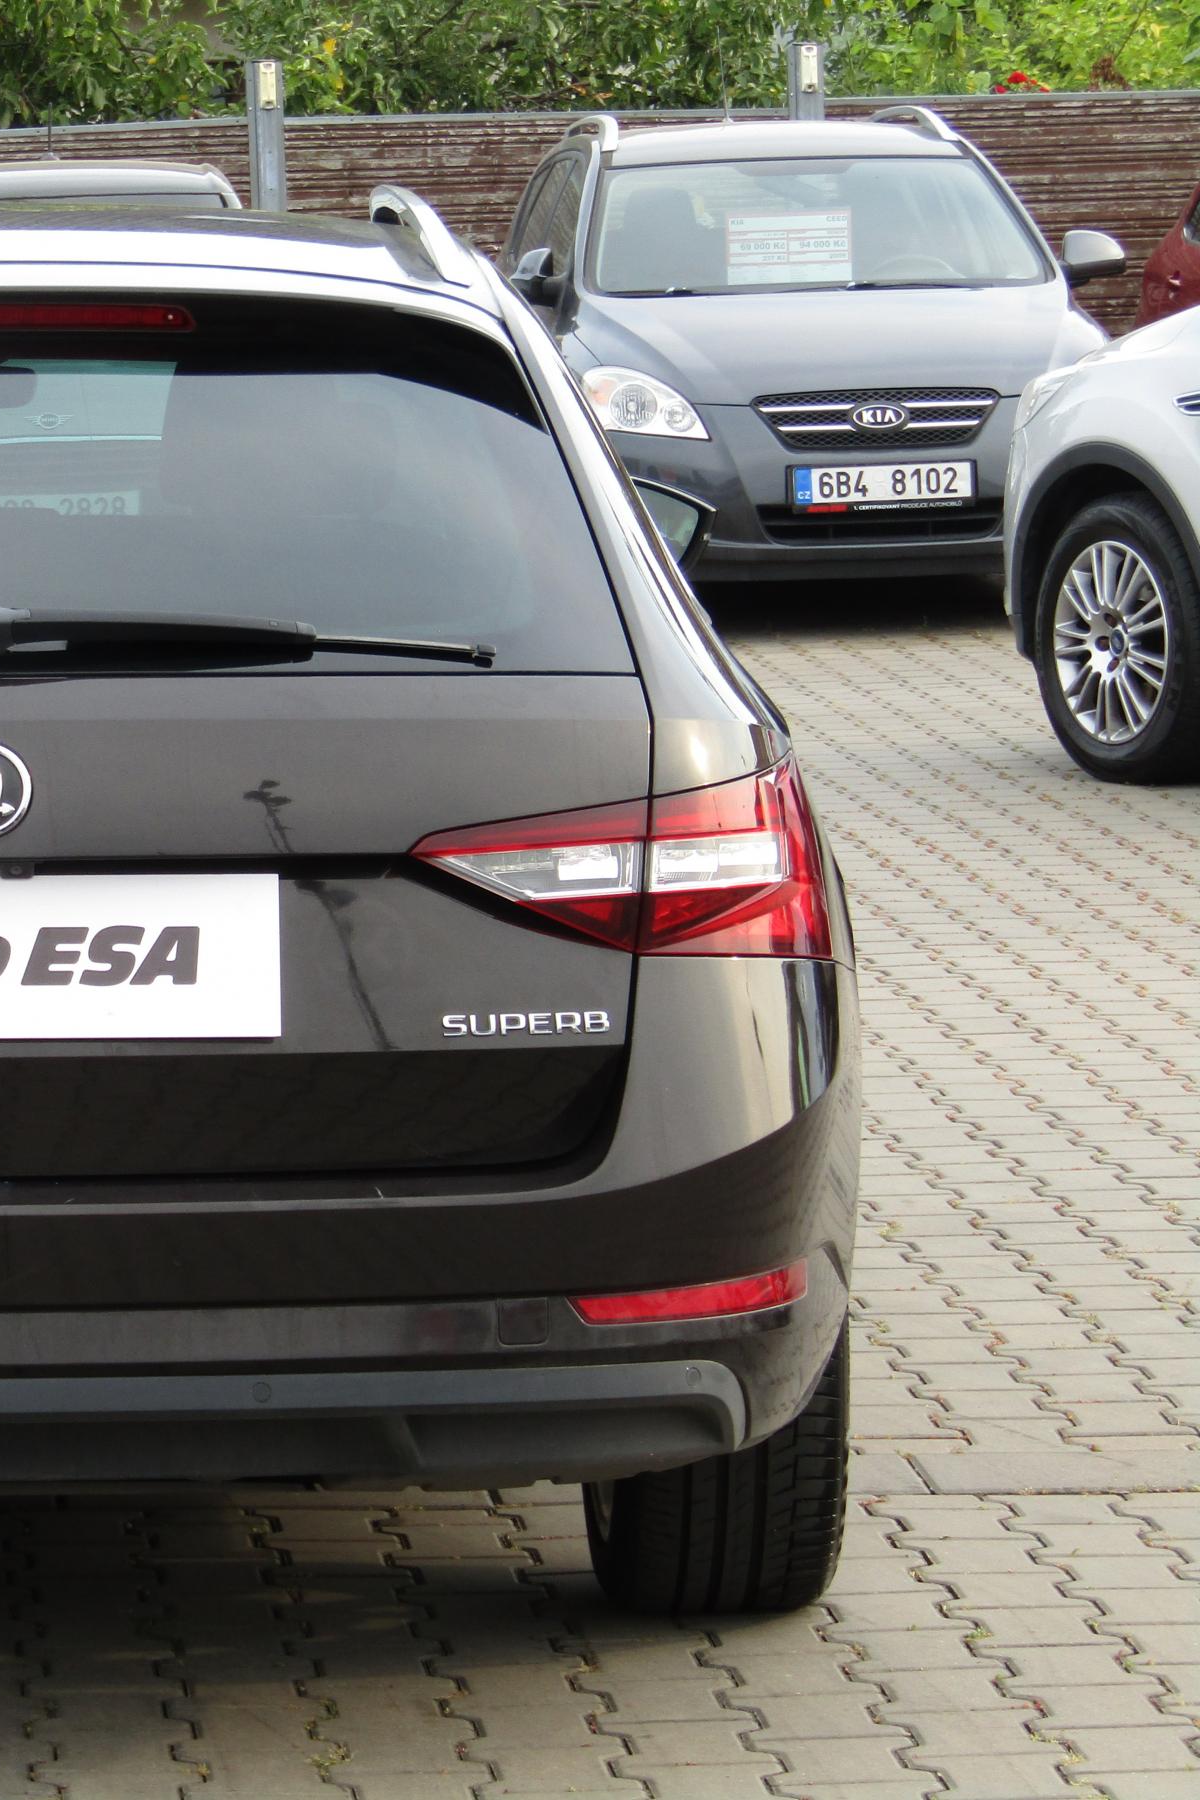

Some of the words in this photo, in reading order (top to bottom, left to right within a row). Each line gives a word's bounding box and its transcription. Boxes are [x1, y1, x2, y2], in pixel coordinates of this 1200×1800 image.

[754, 242, 770, 250] 000
[773, 241, 785, 249] Kč
[813, 239, 830, 248] 000
[833, 238, 846, 247] Kč
[862, 409, 897, 424] KIA
[818, 470, 869, 498] 6B4
[891, 467, 959, 496] 8102
[797, 490, 811, 500] CZ
[20, 925, 201, 987] ESA
[442, 1011, 610, 1037] SUPERB
